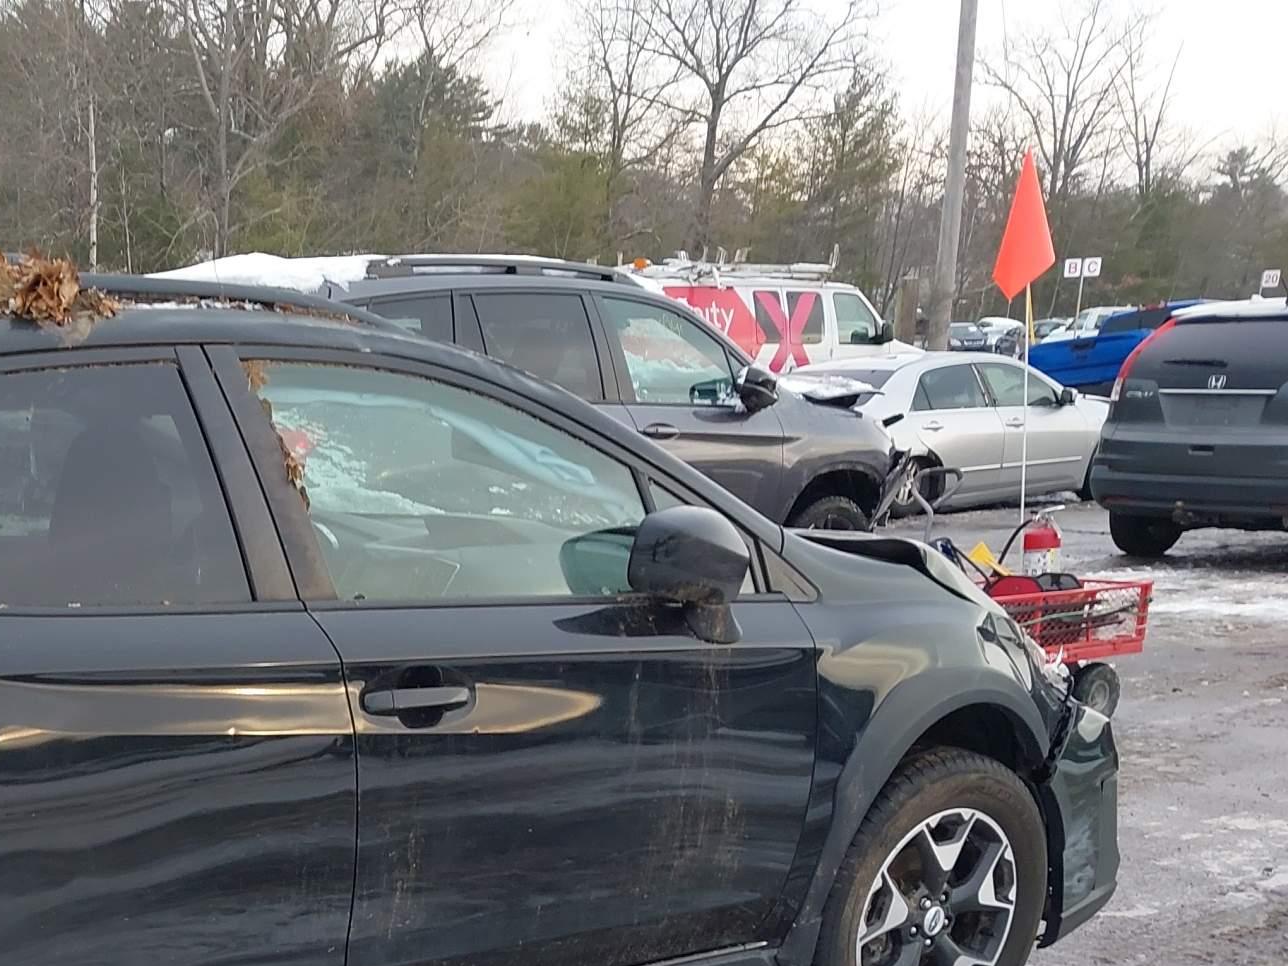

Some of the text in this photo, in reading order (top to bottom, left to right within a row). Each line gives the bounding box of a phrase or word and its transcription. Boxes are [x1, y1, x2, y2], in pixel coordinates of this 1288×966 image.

[1068, 262, 1078, 274] B
[1087, 260, 1098, 273] C
[1264, 271, 1279, 284] 20
